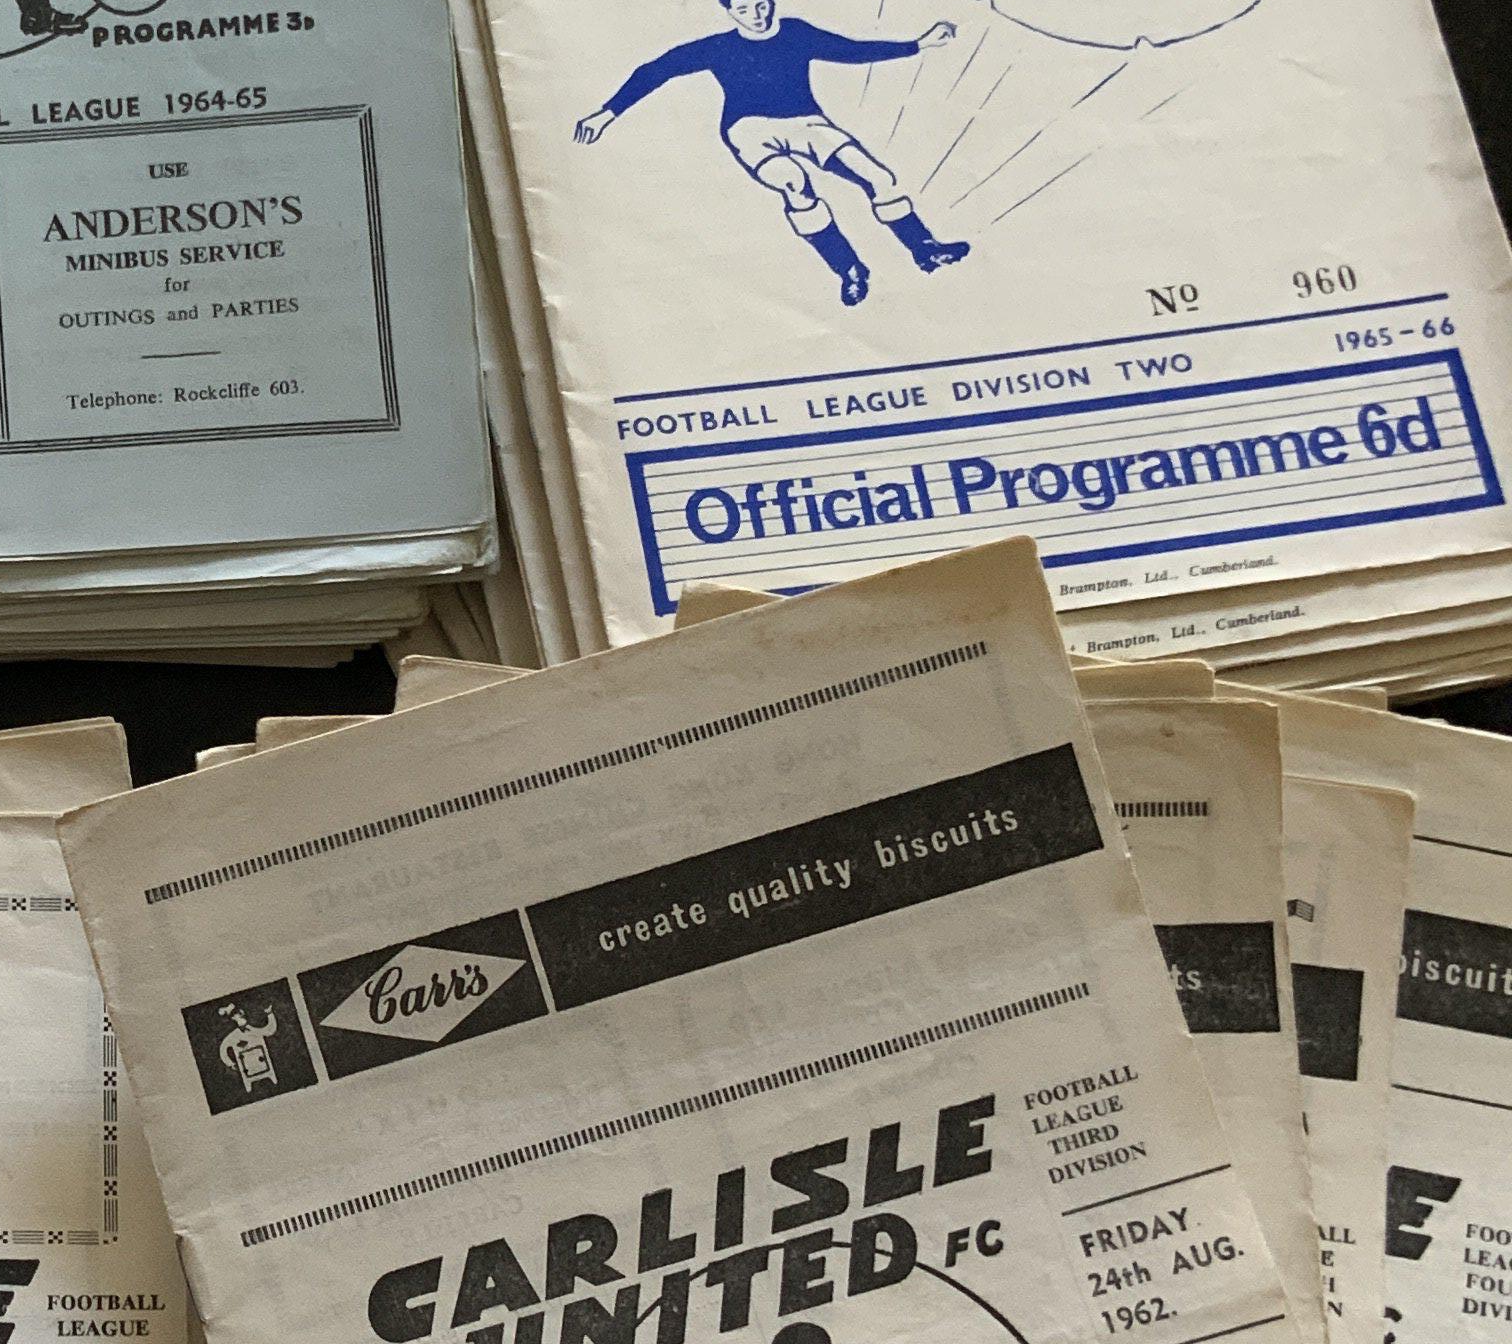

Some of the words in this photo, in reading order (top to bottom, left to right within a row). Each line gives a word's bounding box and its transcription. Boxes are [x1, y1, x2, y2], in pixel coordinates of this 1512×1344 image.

[32, 97, 140, 124] LEAGUE
[166, 87, 266, 114] 1964-65
[44, 196, 302, 242] ANDERSON'S
[66, 250, 168, 272] MINIBUS
[180, 240, 285, 264] SERVICE
[1293, 266, 1356, 298] 960
[59, 309, 155, 328] OUTINGS
[167, 305, 198, 321] and
[212, 298, 298, 318] PARTIES
[65, 391, 164, 410] Telephone:
[174, 383, 259, 402] Rockcliffe
[617, 405, 777, 440] FOOTBALL
[807, 387, 927, 418] LEAGUE
[952, 367, 1090, 401] DIVISION
[1115, 354, 1192, 380] TWO
[684, 466, 936, 544] Official
[947, 422, 1350, 513] Programme
[1359, 396, 1443, 459] 6d
[599, 904, 706, 951] create
[729, 859, 850, 918] quality
[874, 810, 1017, 868] biscuits
[368, 1092, 997, 1344] CARLISLE
[1088, 1261, 1151, 1297] 24th
[1173, 1237, 1244, 1274] AUG.
[48, 1294, 166, 1311] FOOTBALL
[58, 1319, 151, 1337] LEAGUE
